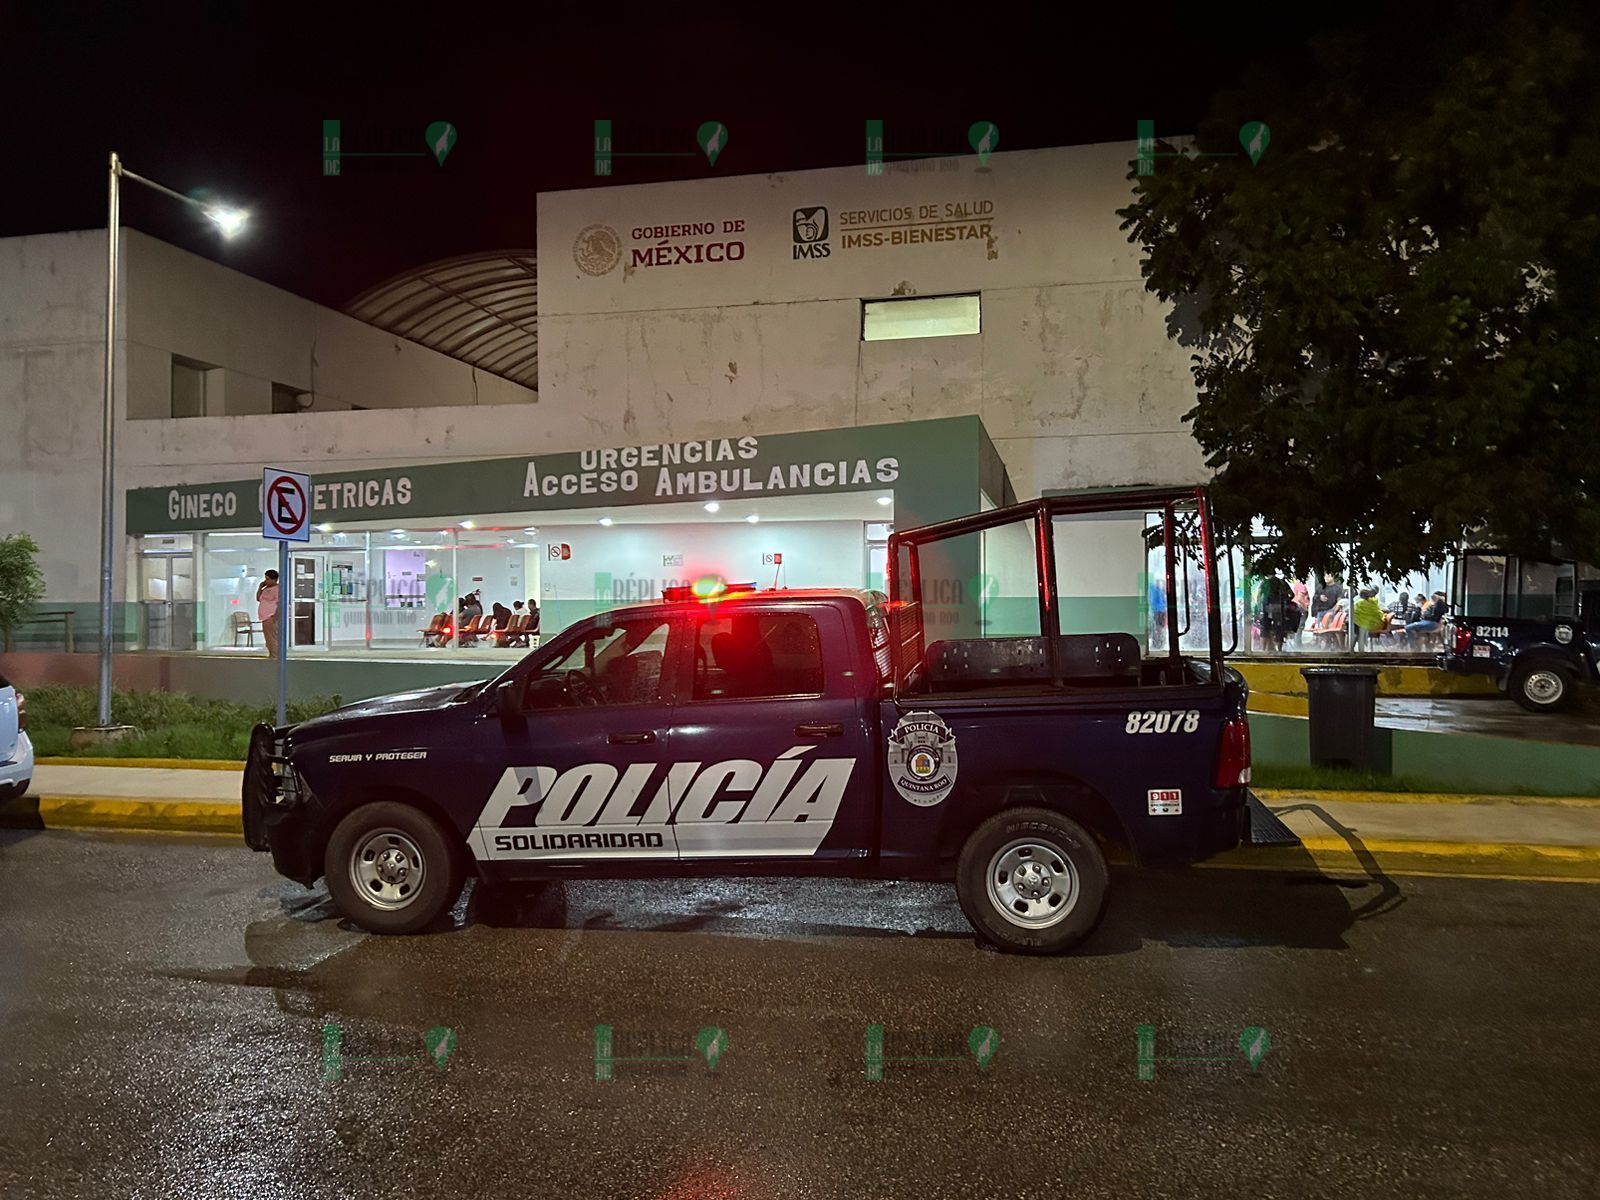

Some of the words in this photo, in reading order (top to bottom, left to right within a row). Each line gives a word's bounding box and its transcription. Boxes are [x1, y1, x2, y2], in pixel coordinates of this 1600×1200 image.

[840, 206, 912, 226] SERVICIOS
[918, 204, 940, 220] DE
[944, 200, 994, 218] SALUD
[631, 221, 715, 240] GOBIERNO
[723, 219, 745, 234] DE
[841, 223, 991, 250] IMSS-BIENESTAR
[631, 240, 745, 268] MÉXICO
[793, 243, 831, 260] IMSS
[580, 435, 759, 471] URGENCIAS
[1475, 625, 1509, 638] 82114
[1125, 709, 1200, 734] 82078
[329, 754, 363, 763] SERVIR
[365, 753, 373, 761] Y
[375, 751, 428, 761] PROTEGER
[474, 745, 857, 827] POLICÍA
[900, 779, 934, 791] QUINTANA
[933, 779, 948, 790] ROO
[1151, 791, 1179, 800] 911
[495, 832, 664, 852] SOLIDARIDAD
